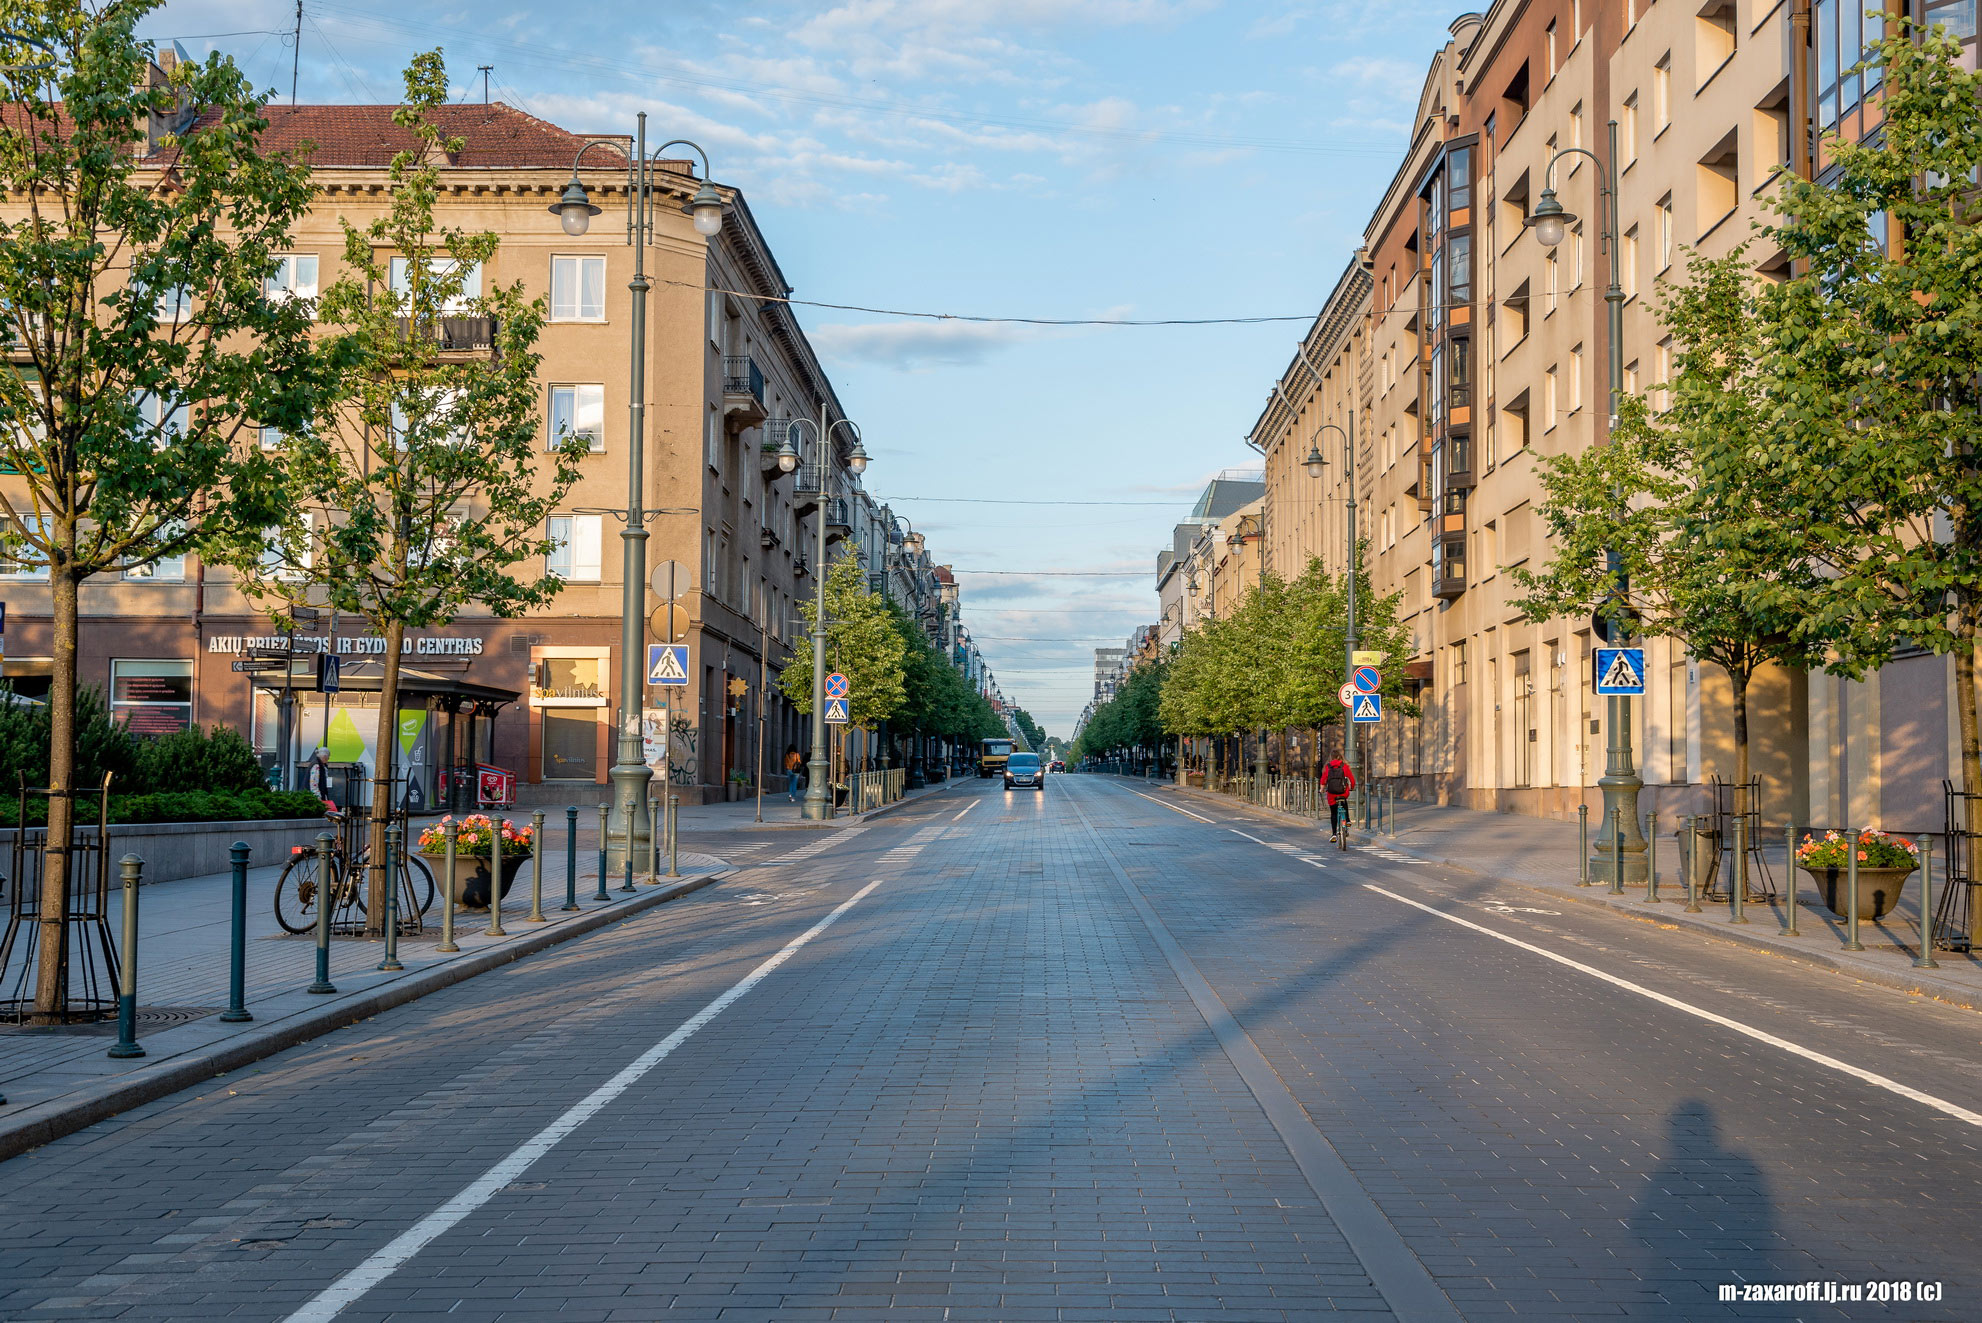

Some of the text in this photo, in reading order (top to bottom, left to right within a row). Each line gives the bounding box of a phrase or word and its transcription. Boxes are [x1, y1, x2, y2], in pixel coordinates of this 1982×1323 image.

[208, 636, 243, 657] AKIŲ
[337, 637, 352, 654] IR
[356, 637, 413, 654] GYDYO
[417, 637, 483, 655] CENTRAS
